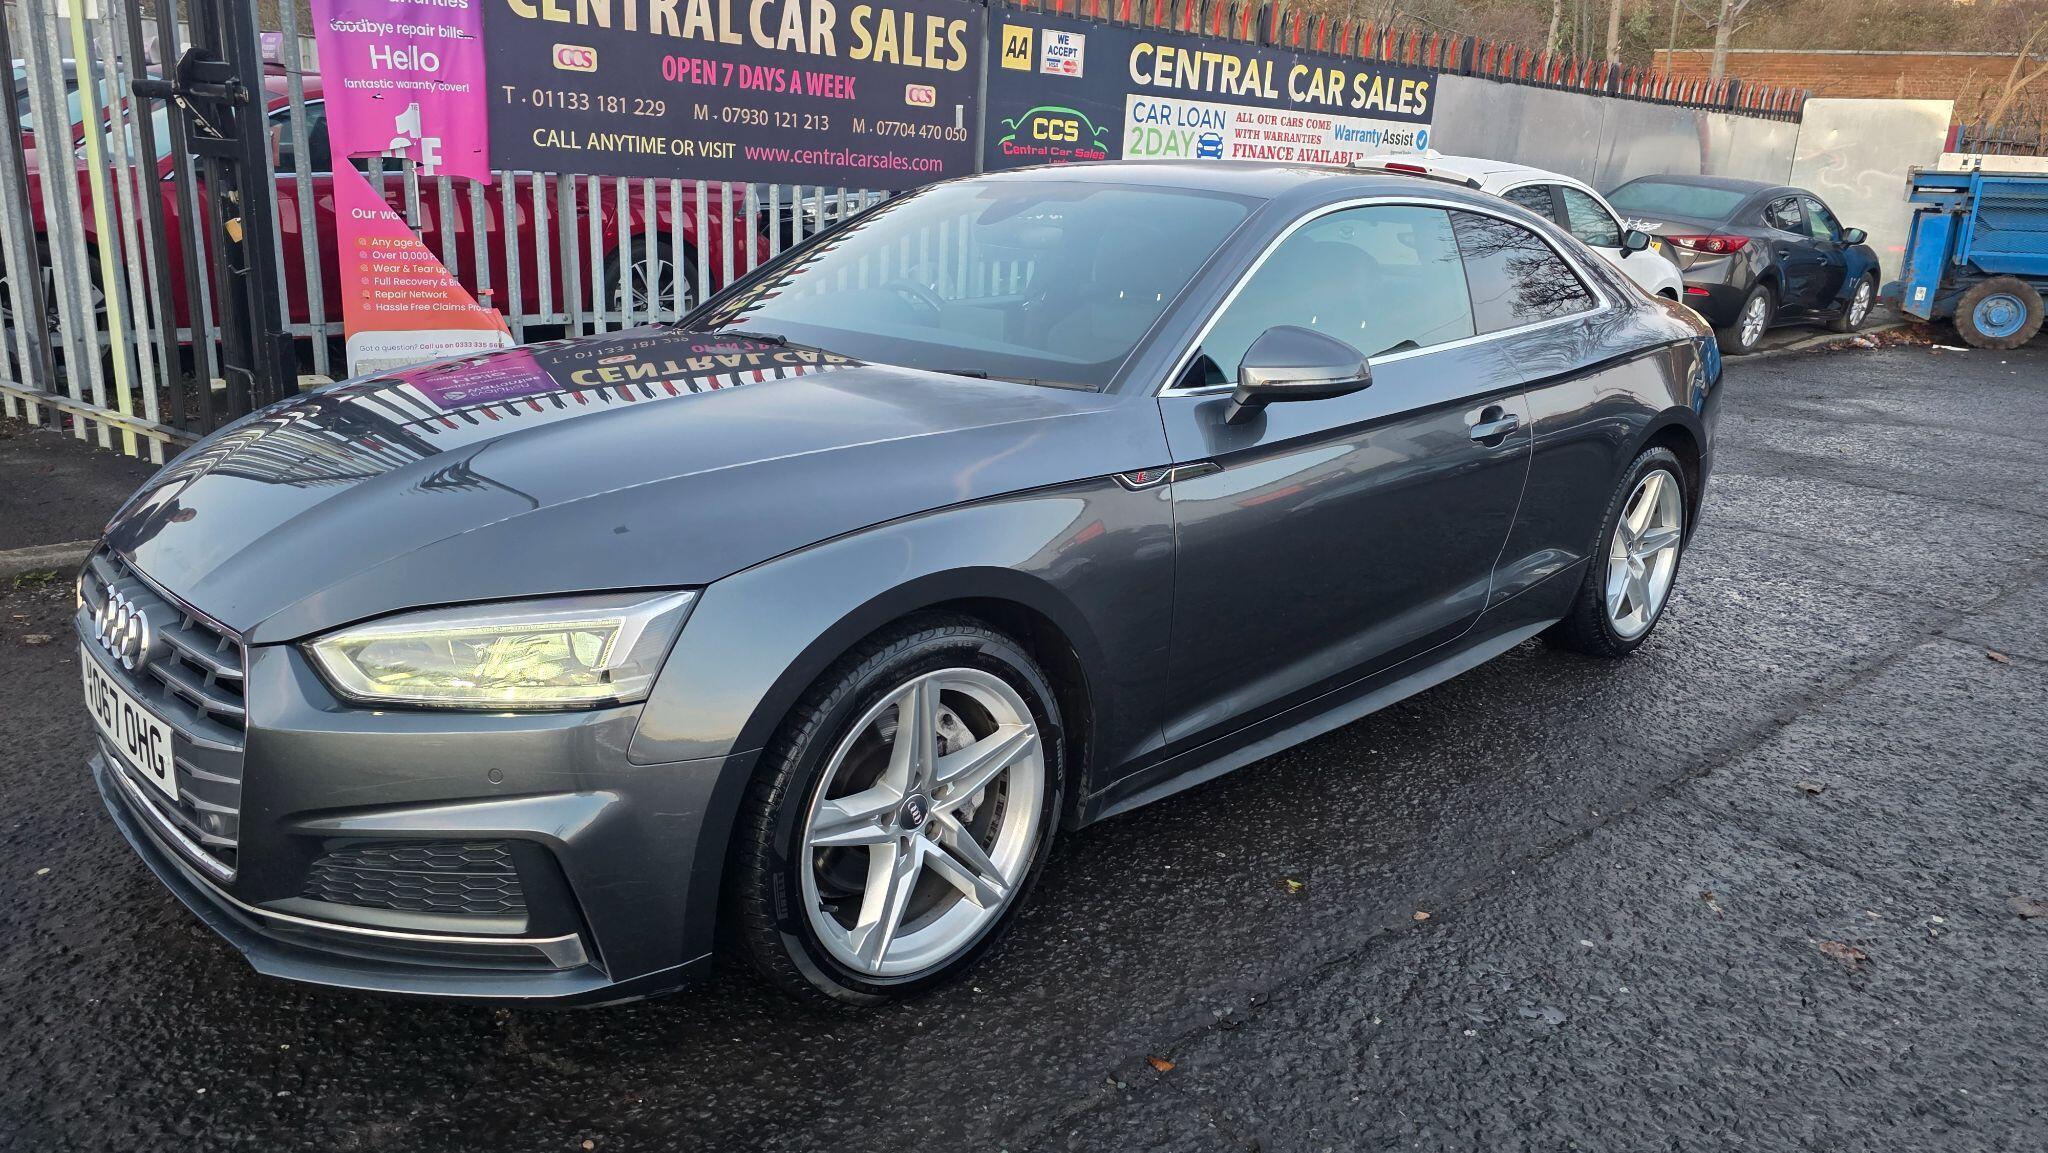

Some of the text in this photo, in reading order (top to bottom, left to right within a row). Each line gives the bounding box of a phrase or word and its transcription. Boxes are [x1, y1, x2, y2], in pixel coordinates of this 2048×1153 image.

[397, 23, 435, 38] repair
[750, 0, 837, 56] CAR
[850, 5, 968, 71] SALES
[1057, 34, 1070, 45] WE
[1005, 35, 1028, 60] AA
[1047, 45, 1078, 58] ACCEPT
[369, 45, 440, 72] Hello
[557, 47, 592, 69] CCS
[344, 78, 394, 89] fantastic
[438, 83, 470, 93] cover!
[661, 55, 856, 100] OPEN 7 DAYS A WEEK
[1129, 42, 1429, 116] CENTRAL CAR SALES
[532, 89, 590, 110] 01133
[597, 96, 626, 114] 181
[634, 99, 666, 117] 229
[722, 106, 769, 126] 07930
[774, 111, 798, 128] 121
[804, 114, 829, 131] 213
[876, 120, 915, 137] 07704
[919, 125, 942, 139] 470
[945, 127, 967, 142] 050
[1133, 102, 1227, 129] CAR LOAN
[1235, 112, 1332, 131] ALL OUR CARS COME
[1033, 117, 1079, 142] CCS
[1234, 128, 1322, 145] WITH WARRANTIES
[1334, 124, 1414, 148] WarrantyAssist
[533, 128, 943, 172] CALL ANYTIME OR VISIT www.centralcarsales.com
[1003, 141, 1105, 160] Central Car Sales
[1130, 126, 1195, 157] 2DAY
[1232, 143, 1364, 165] FINANCE AVAILABLE
[351, 207, 402, 220] Our wa
[371, 238, 391, 248] Any
[394, 240, 413, 250] age
[372, 251, 397, 260] Over
[372, 264, 400, 273] Wear
[403, 264, 410, 273] &
[412, 265, 434, 273] Tear
[374, 277, 391, 286] Full
[394, 277, 438, 288] Recovery
[375, 290, 448, 303] Repair Network
[376, 303, 409, 311] Hassle
[410, 303, 431, 311] Free
[432, 303, 466, 311] Claims
[419, 342, 434, 350] Call
[85, 655, 165, 780] YO67 OHG
